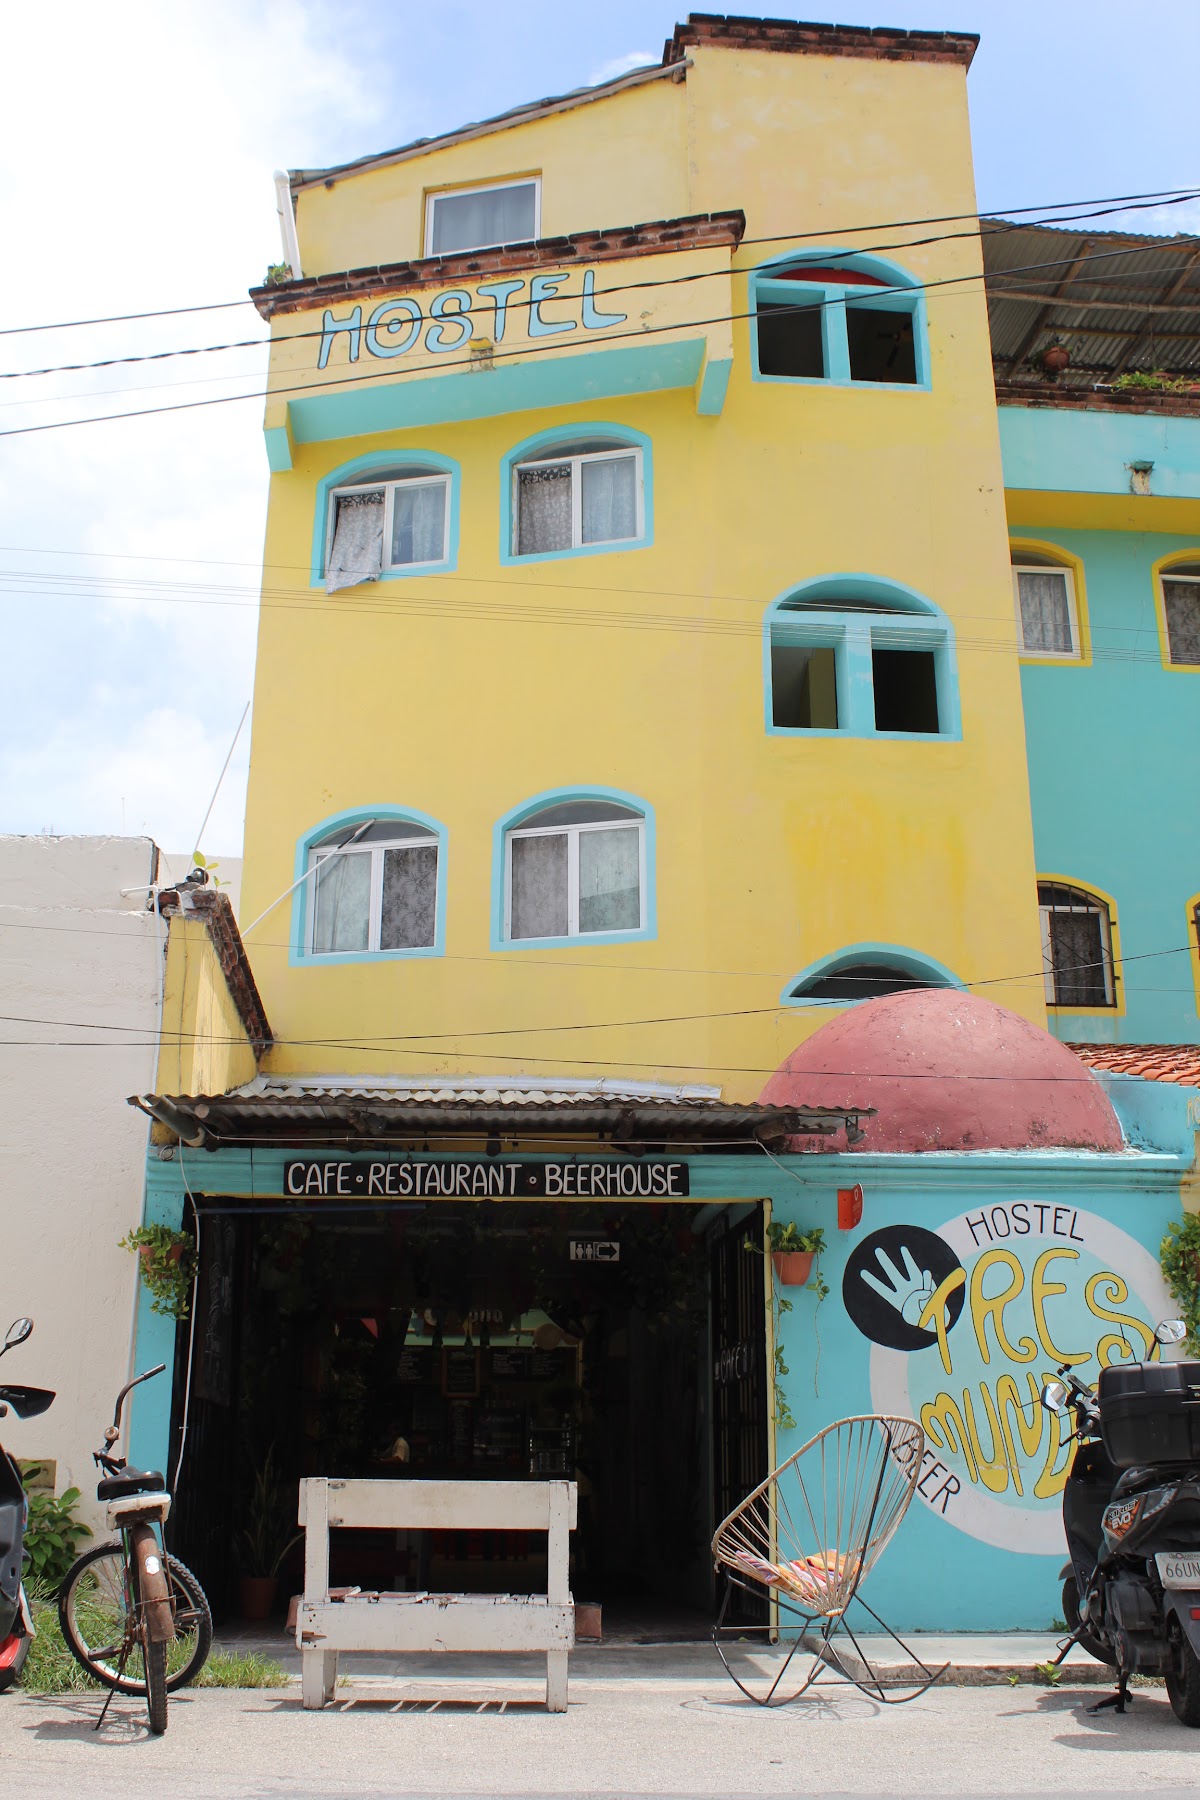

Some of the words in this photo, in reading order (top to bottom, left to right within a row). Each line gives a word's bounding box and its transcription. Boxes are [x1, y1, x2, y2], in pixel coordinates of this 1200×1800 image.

[316, 269, 628, 370] HOSTEL
[287, 1161, 352, 1195] CAFE
[367, 1162, 523, 1196] RESTAURANT
[544, 1162, 684, 1196] BEERHOUSE
[965, 1203, 1085, 1247] HOSTEL
[918, 1247, 1161, 1376] TRES
[891, 1434, 961, 1514] BEER
[920, 1371, 1100, 1499] MUND
[1111, 1511, 1131, 1530] EVO
